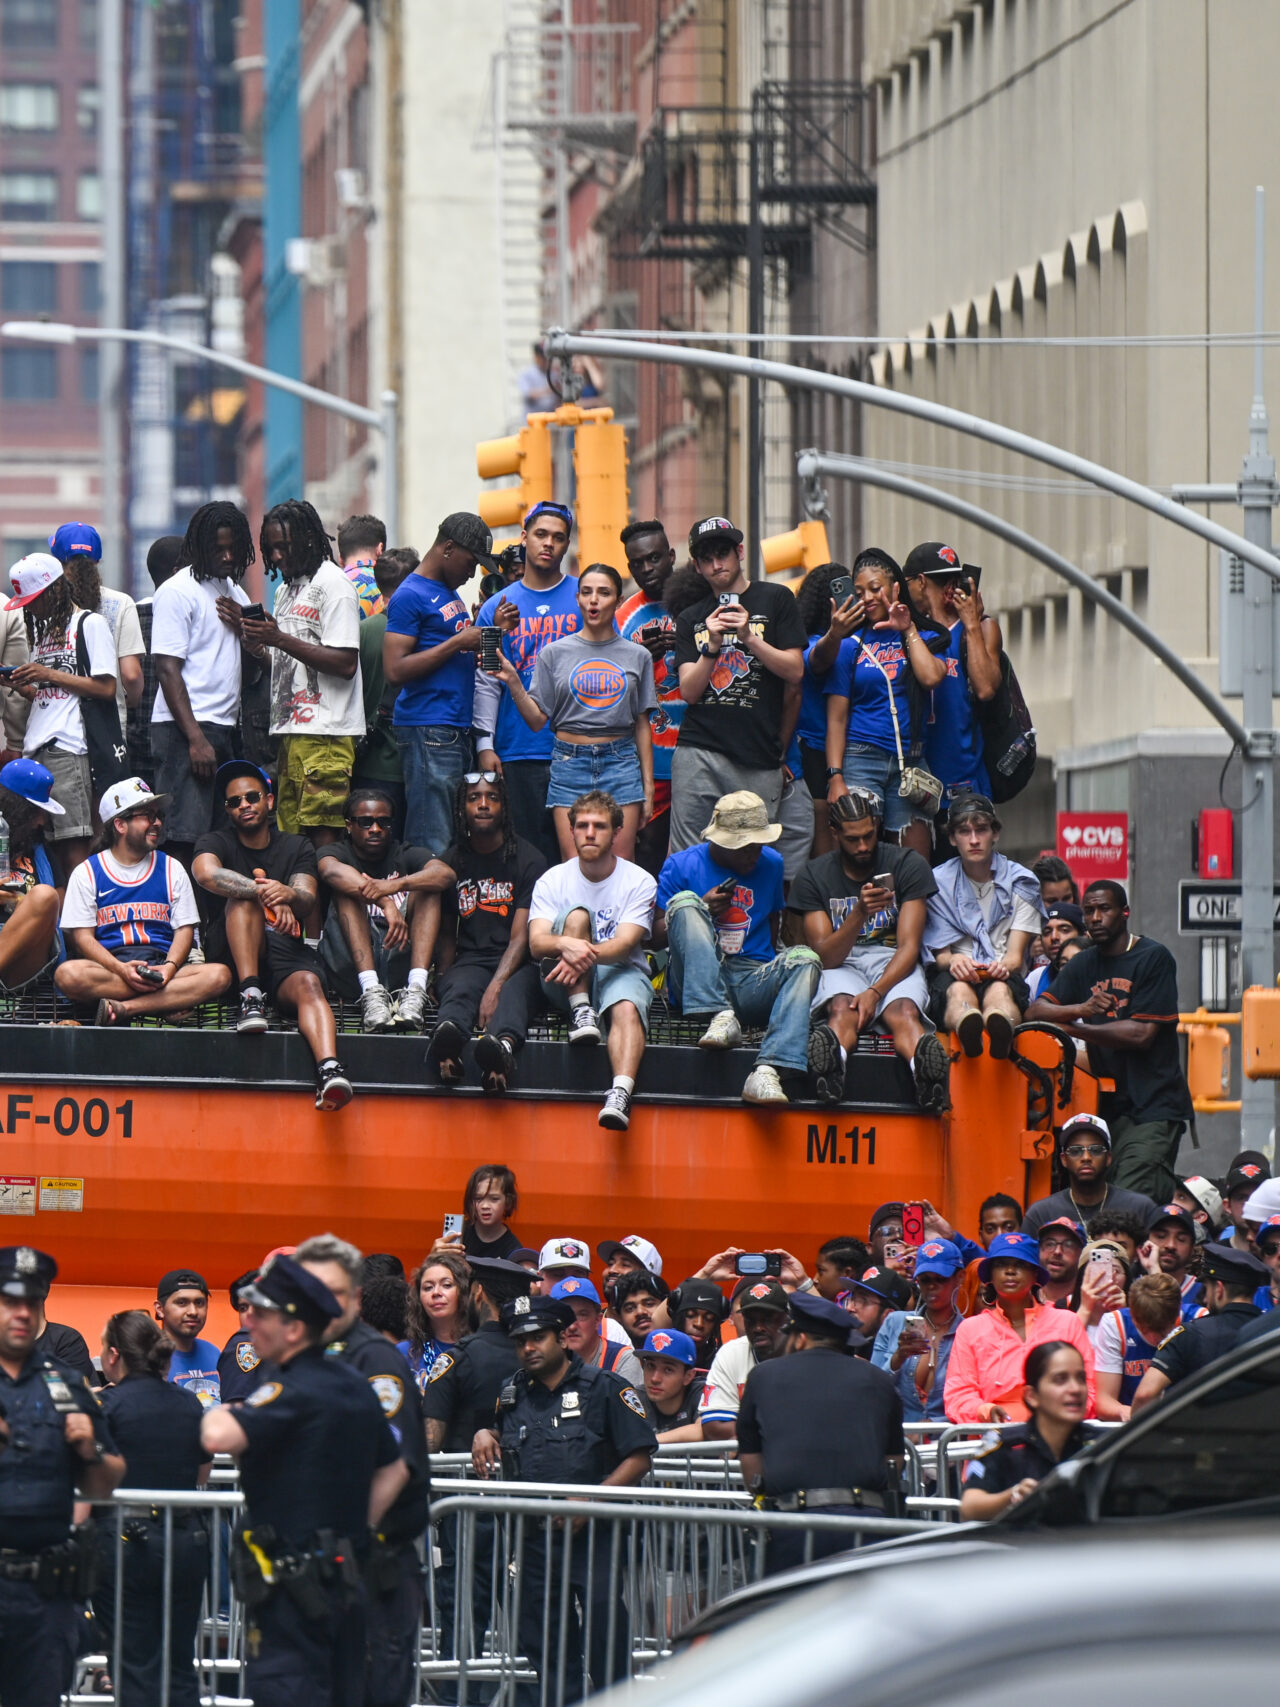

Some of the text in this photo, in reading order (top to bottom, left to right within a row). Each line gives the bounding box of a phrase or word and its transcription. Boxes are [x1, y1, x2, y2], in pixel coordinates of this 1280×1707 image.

[577, 672, 621, 696] KNICKS
[1083, 826, 1123, 845] CVS
[1066, 845, 1121, 860] pharmacy
[97, 901, 170, 927] NEW YORK
[1197, 896, 1237, 920] ONE
[120, 922, 151, 946] 11
[806, 1125, 876, 1164] M.11
